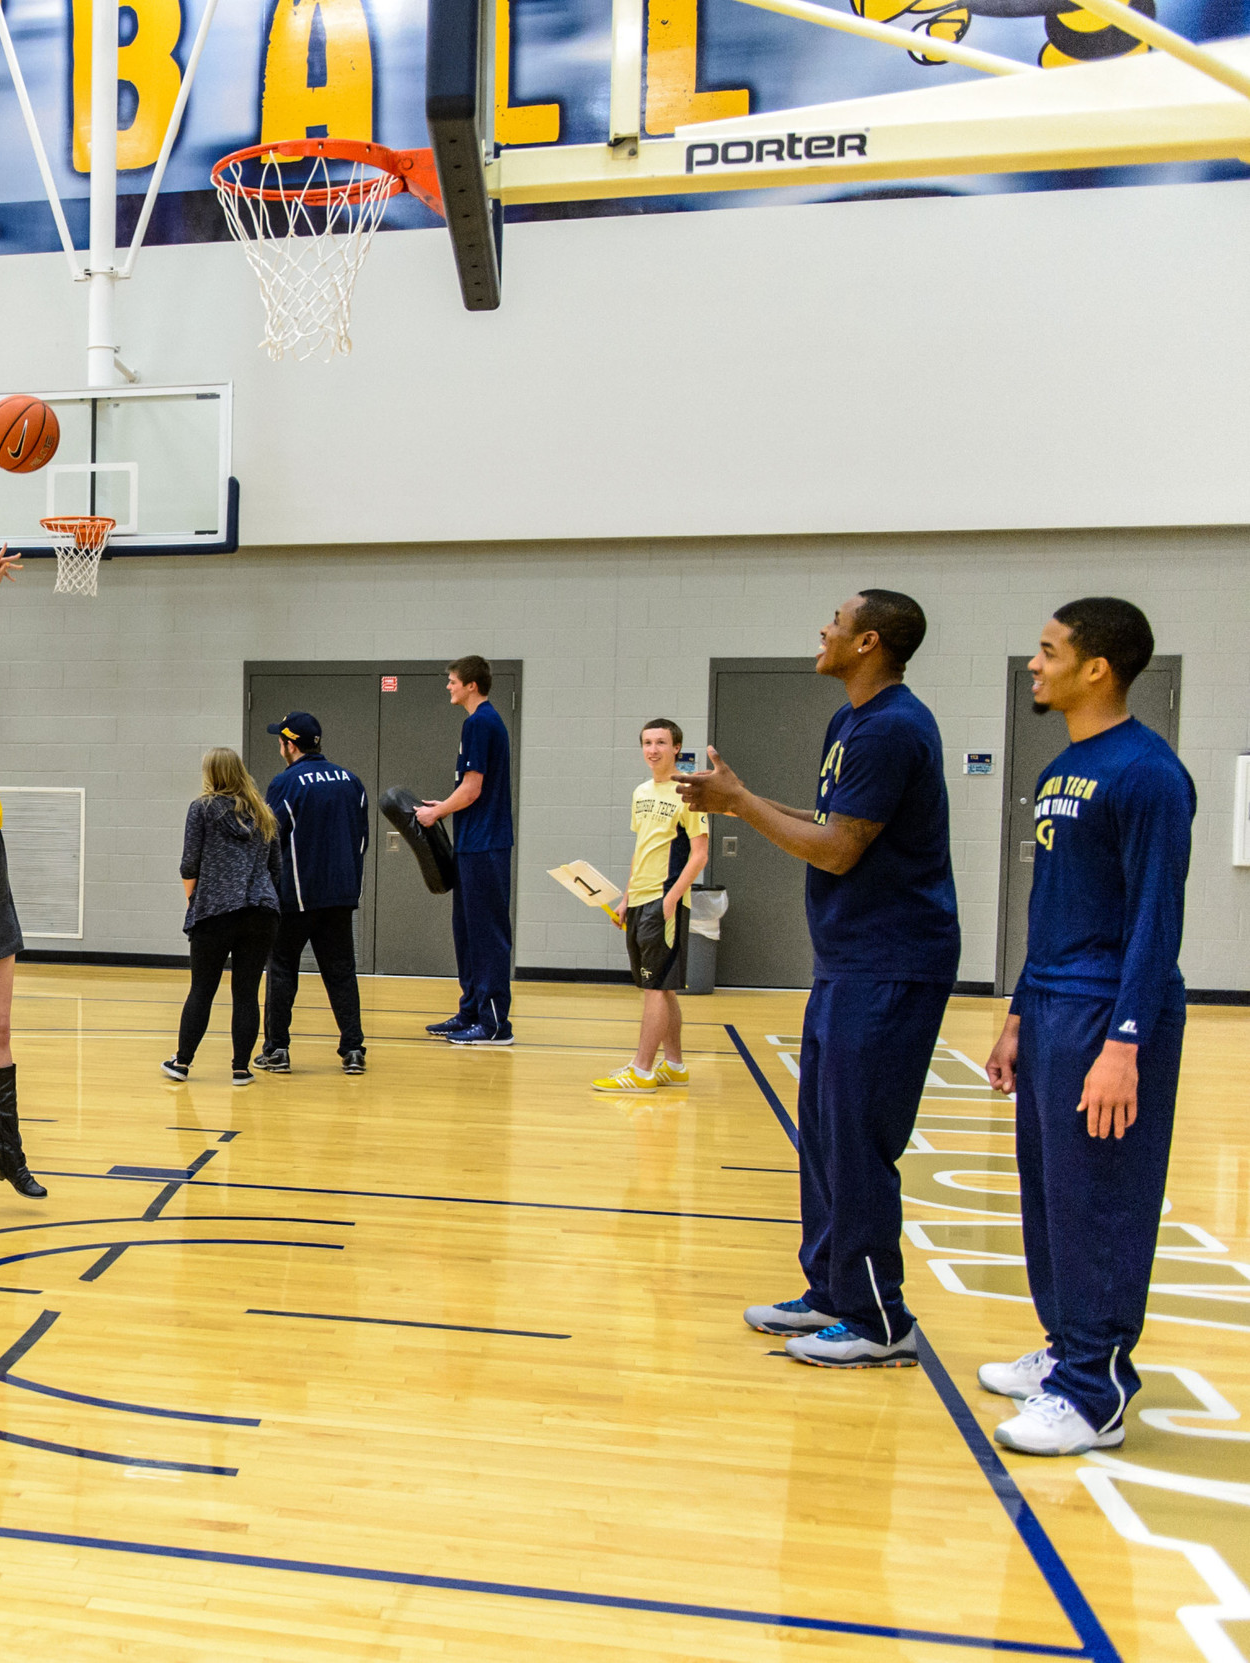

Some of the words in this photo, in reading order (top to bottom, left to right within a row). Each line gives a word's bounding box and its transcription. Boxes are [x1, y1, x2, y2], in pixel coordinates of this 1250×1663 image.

[298, 770, 351, 786] ITALIA
[1064, 775, 1098, 800] TECH
[573, 875, 602, 897] 1
